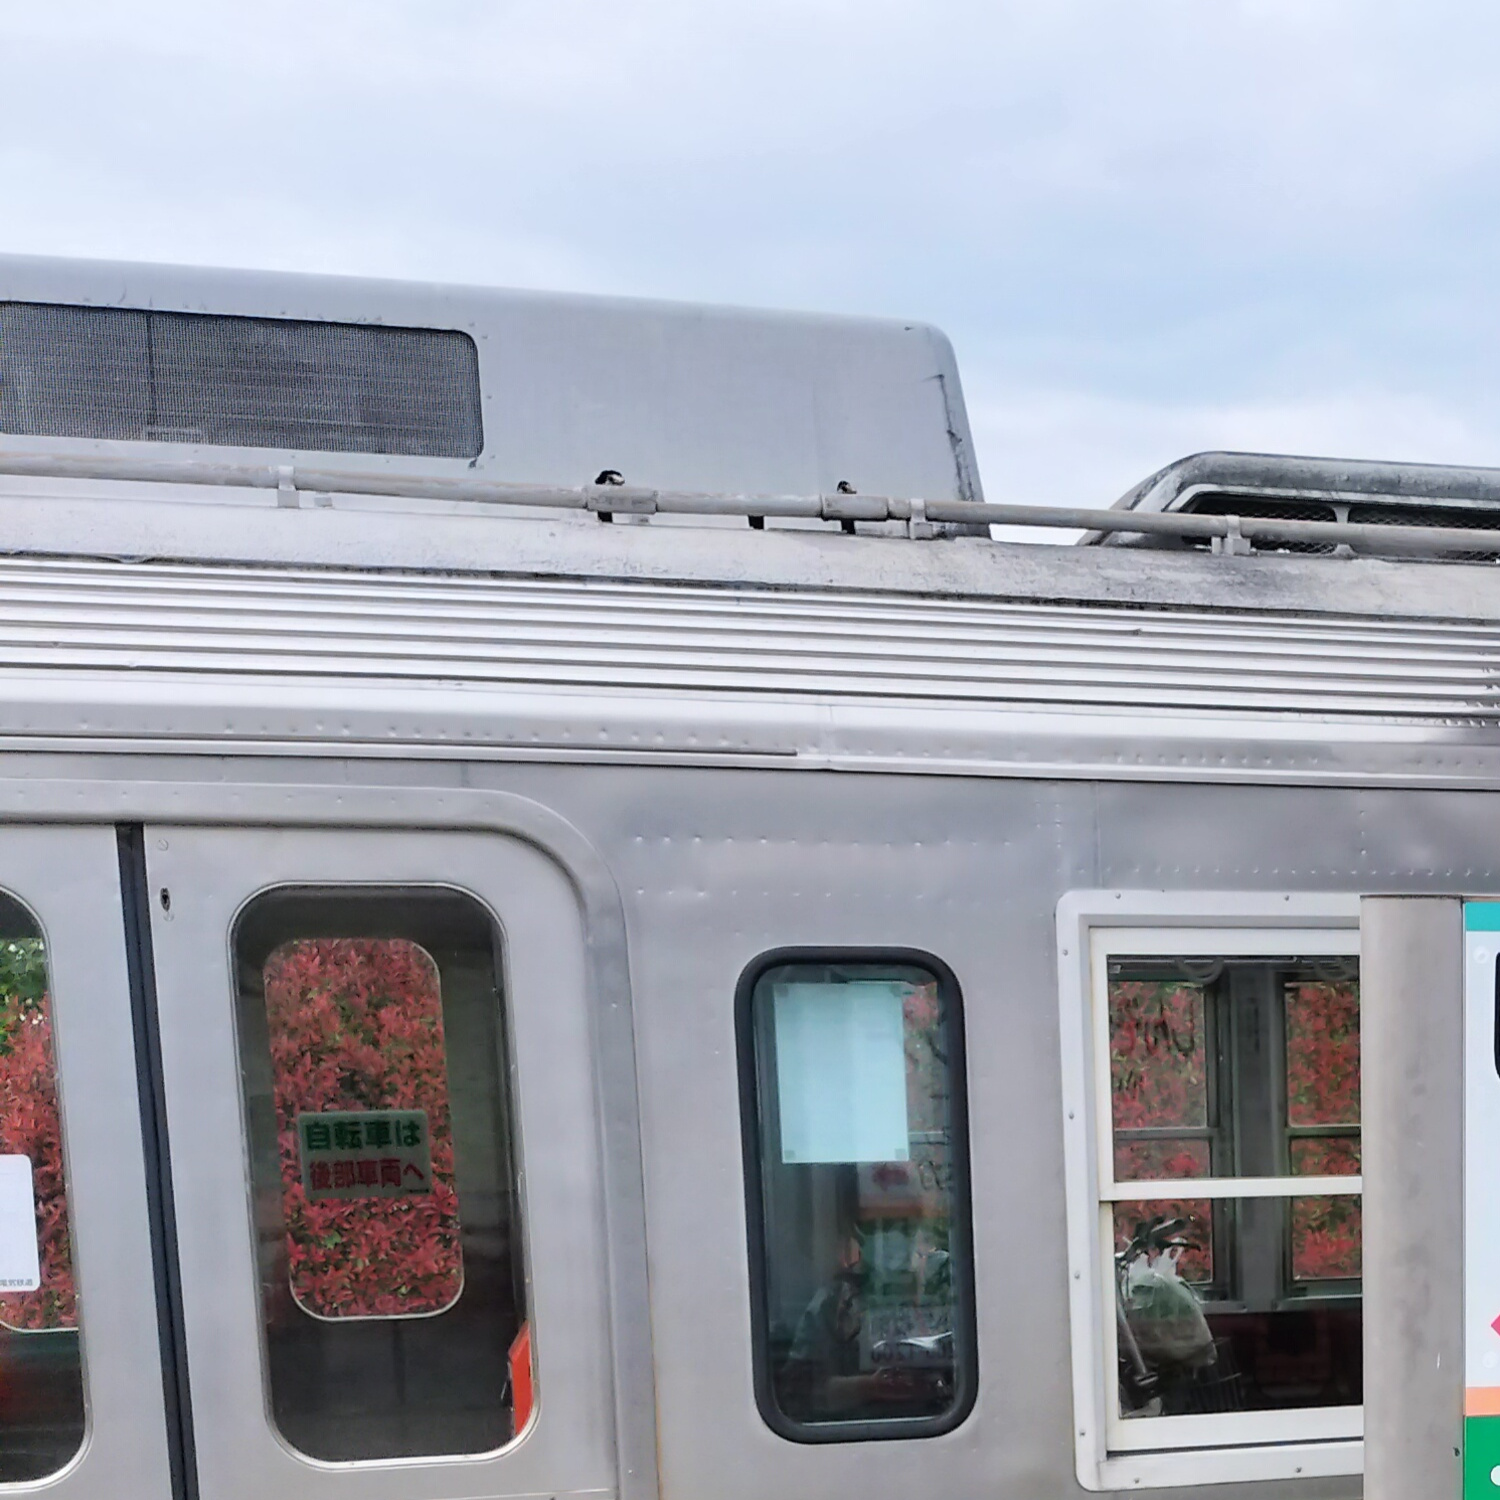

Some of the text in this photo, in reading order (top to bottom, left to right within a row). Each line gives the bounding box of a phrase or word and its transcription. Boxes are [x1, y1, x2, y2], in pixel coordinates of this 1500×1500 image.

[305, 1120, 421, 1150] 自転車は
[309, 1158, 425, 1191] 後部車両へ
